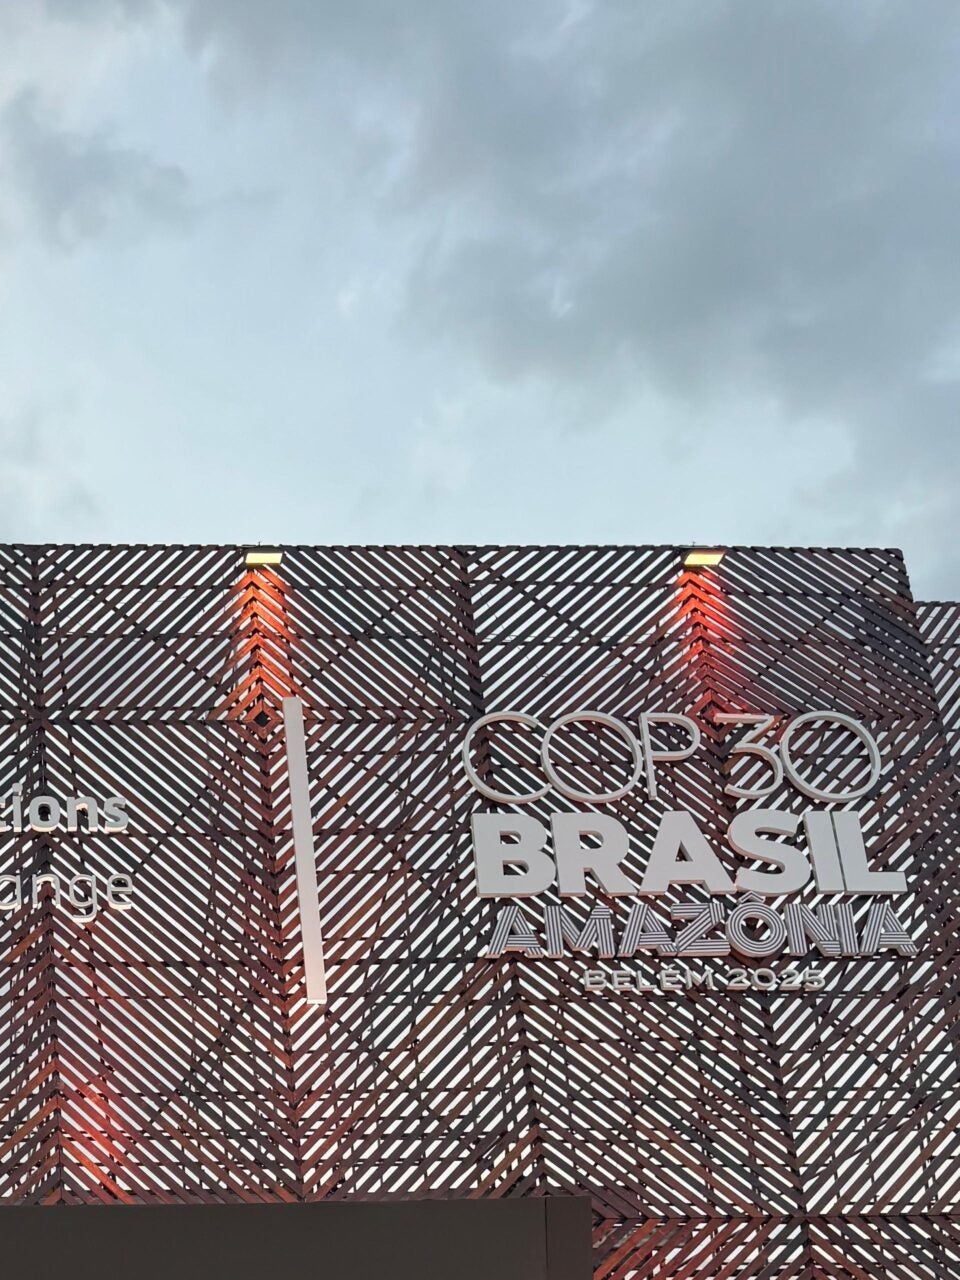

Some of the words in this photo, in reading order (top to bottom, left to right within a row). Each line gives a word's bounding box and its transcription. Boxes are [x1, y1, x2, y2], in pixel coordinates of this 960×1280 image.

[471, 808, 908, 898] BRASIL
[485, 891, 919, 959] AMAZÔNIA
[583, 963, 715, 991] BELÉM
[725, 968, 827, 991] 2025
